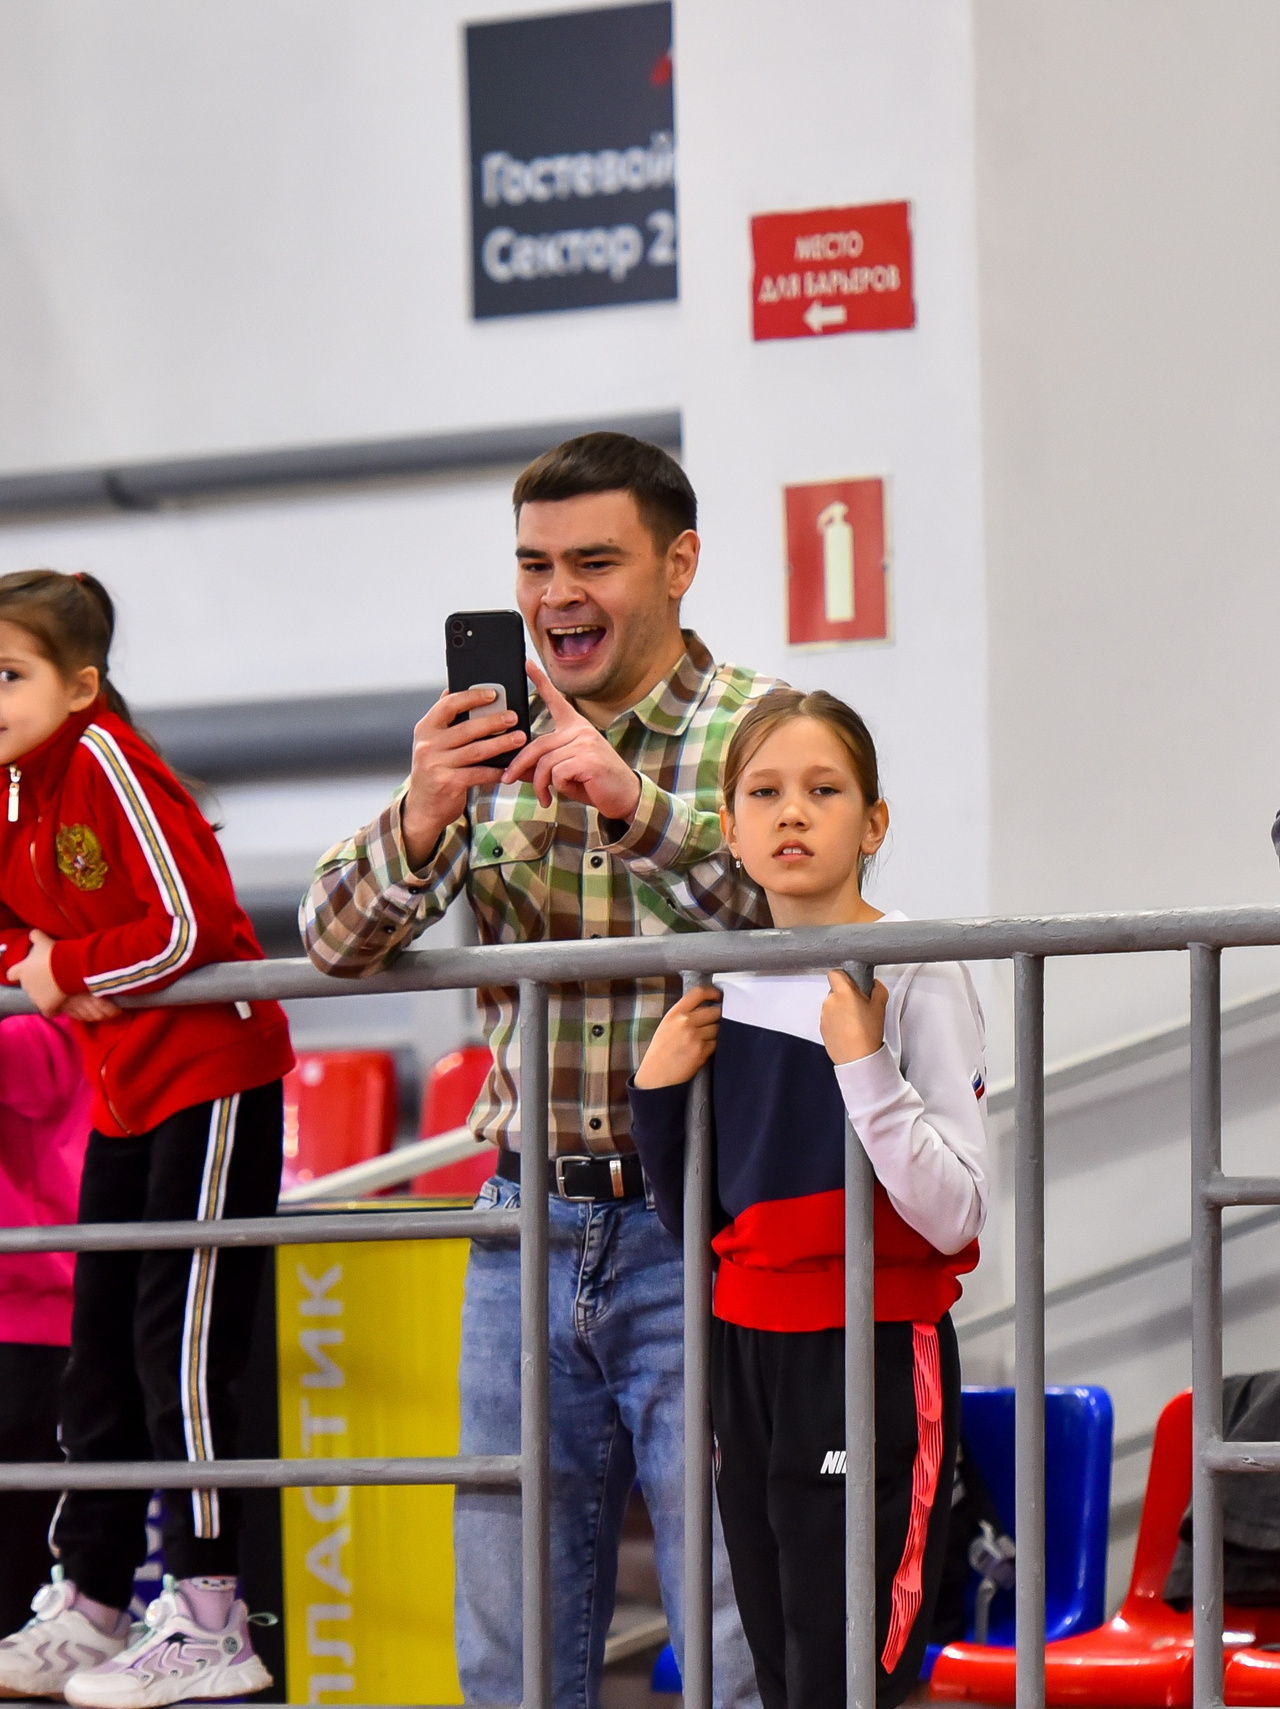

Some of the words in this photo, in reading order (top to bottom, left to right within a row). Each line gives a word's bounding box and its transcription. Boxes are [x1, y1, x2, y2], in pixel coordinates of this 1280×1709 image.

[481, 130, 675, 206] Гостевой
[482, 223, 644, 283] Сектор
[646, 208, 675, 267] 2
[794, 229, 864, 262] МЕСТО
[759, 272, 802, 304] ДЛЯ
[820, 1450, 847, 1474] NI
